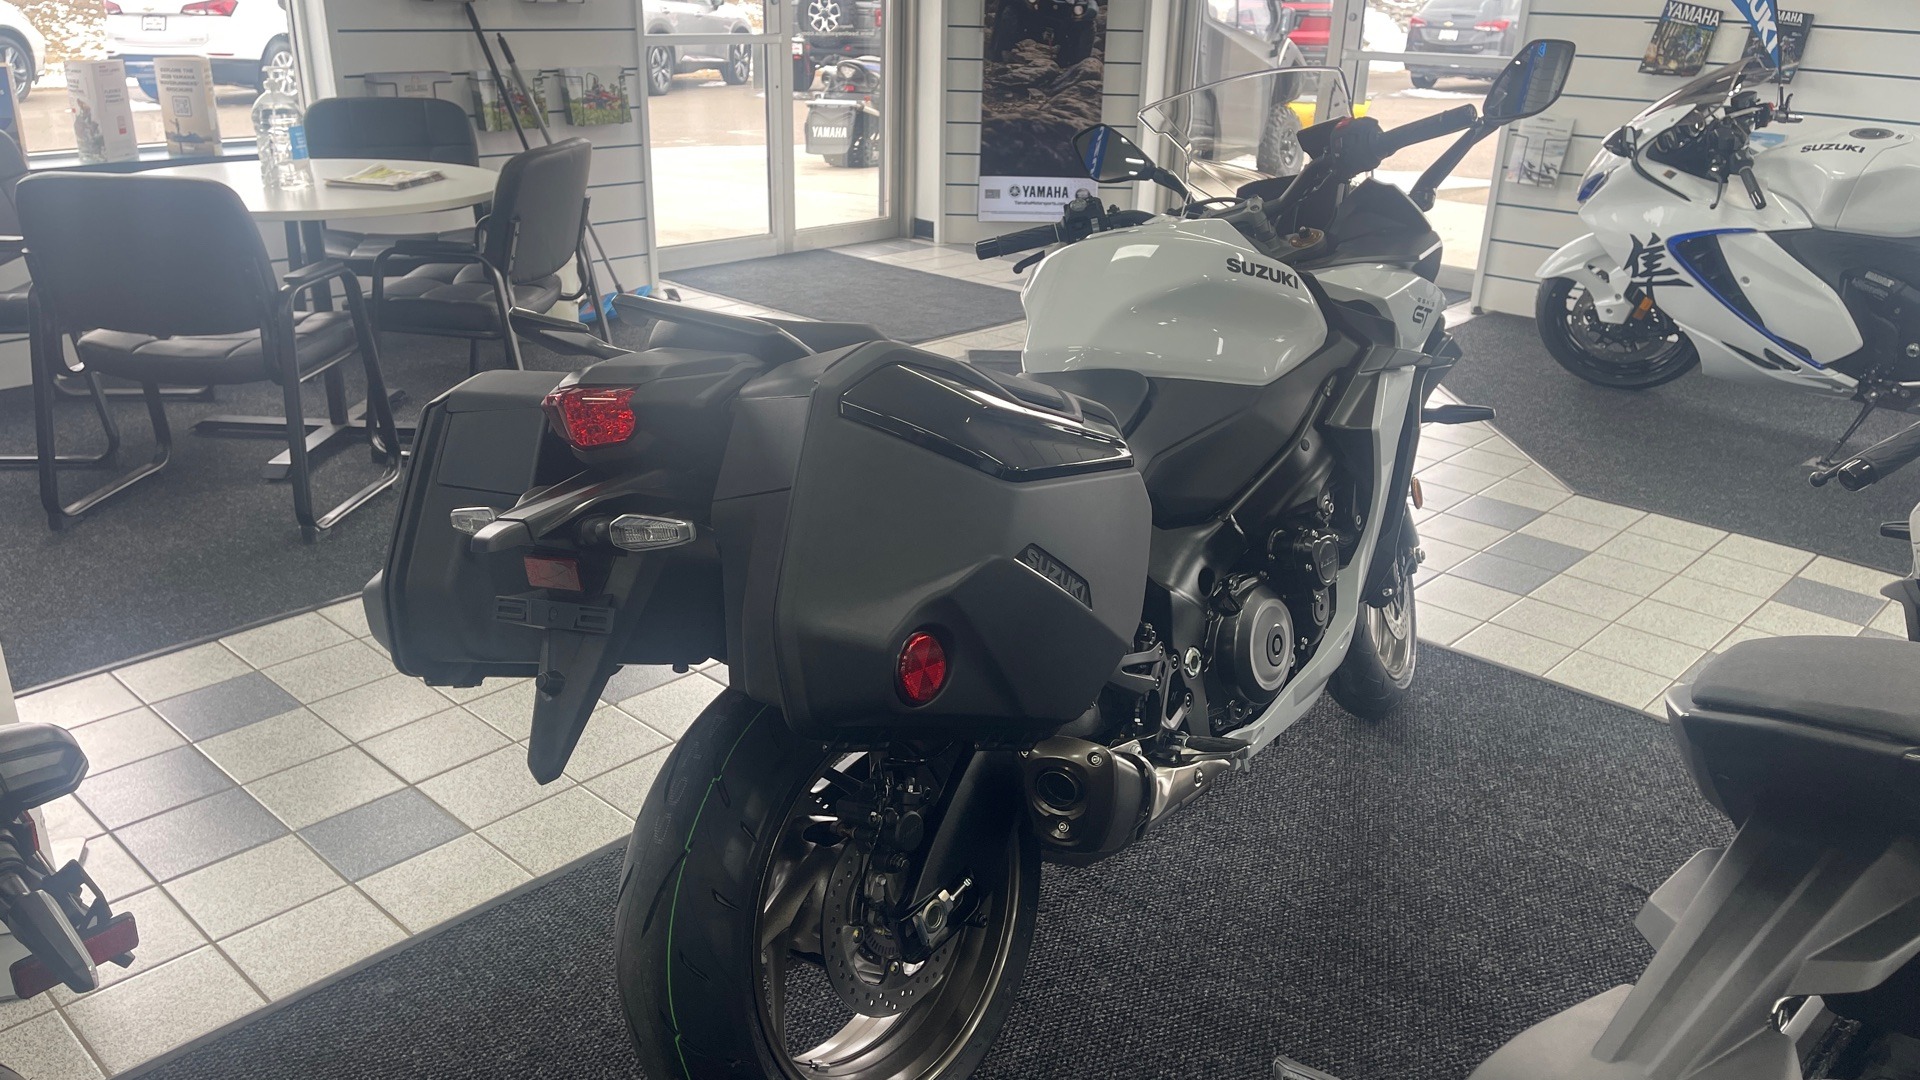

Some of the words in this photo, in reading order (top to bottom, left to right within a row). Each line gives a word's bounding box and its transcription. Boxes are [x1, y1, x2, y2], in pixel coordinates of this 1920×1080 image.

[1667, 1, 1720, 27] YAMAHA
[1745, 0, 1778, 54] UKI
[1777, 10, 1804, 24] MAHA
[812, 127, 848, 138] YAMAHA
[1800, 143, 1866, 154] SUZUKI
[1022, 185, 1069, 199] YAMAHA
[1226, 257, 1299, 290] SUZUKI
[1412, 305, 1433, 331] GT
[1025, 548, 1086, 602] SUZUKI
